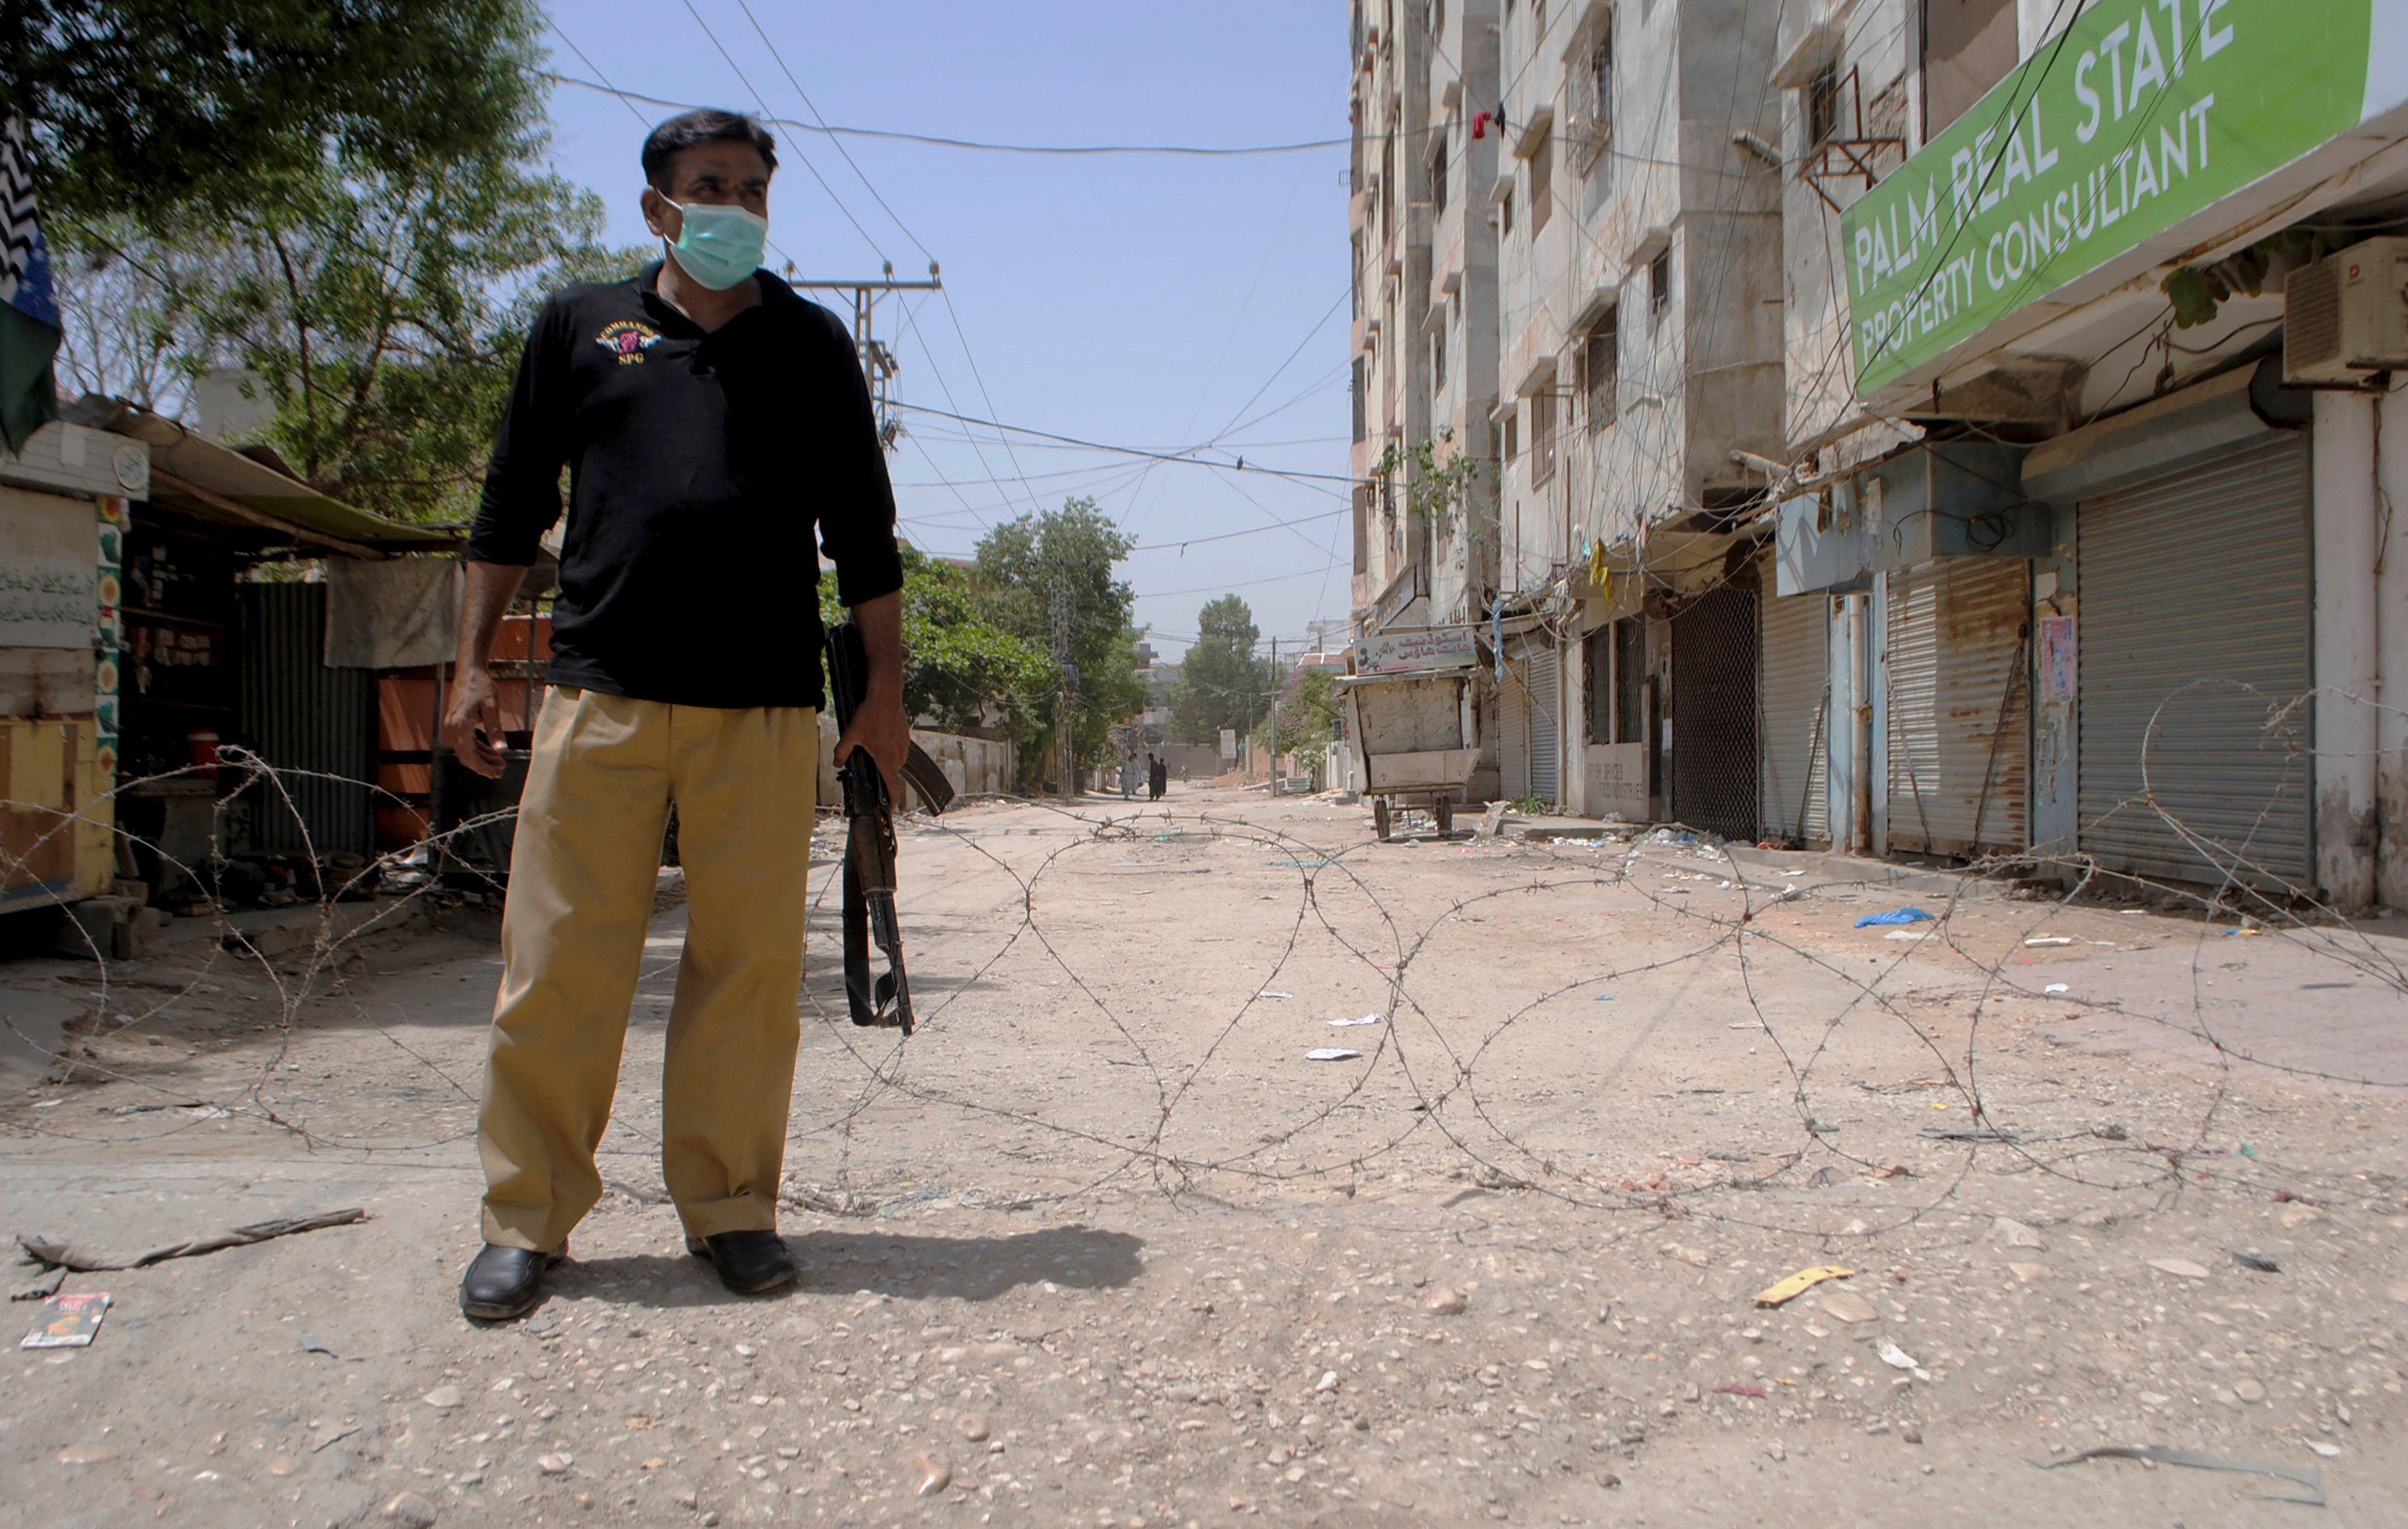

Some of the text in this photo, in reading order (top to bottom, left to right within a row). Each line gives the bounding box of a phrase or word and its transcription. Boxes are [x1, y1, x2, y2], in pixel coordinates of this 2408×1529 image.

[1855, 0, 2234, 297] PALM REAL STATE
[1862, 92, 2214, 366] PROPERTY CONSULTANT
